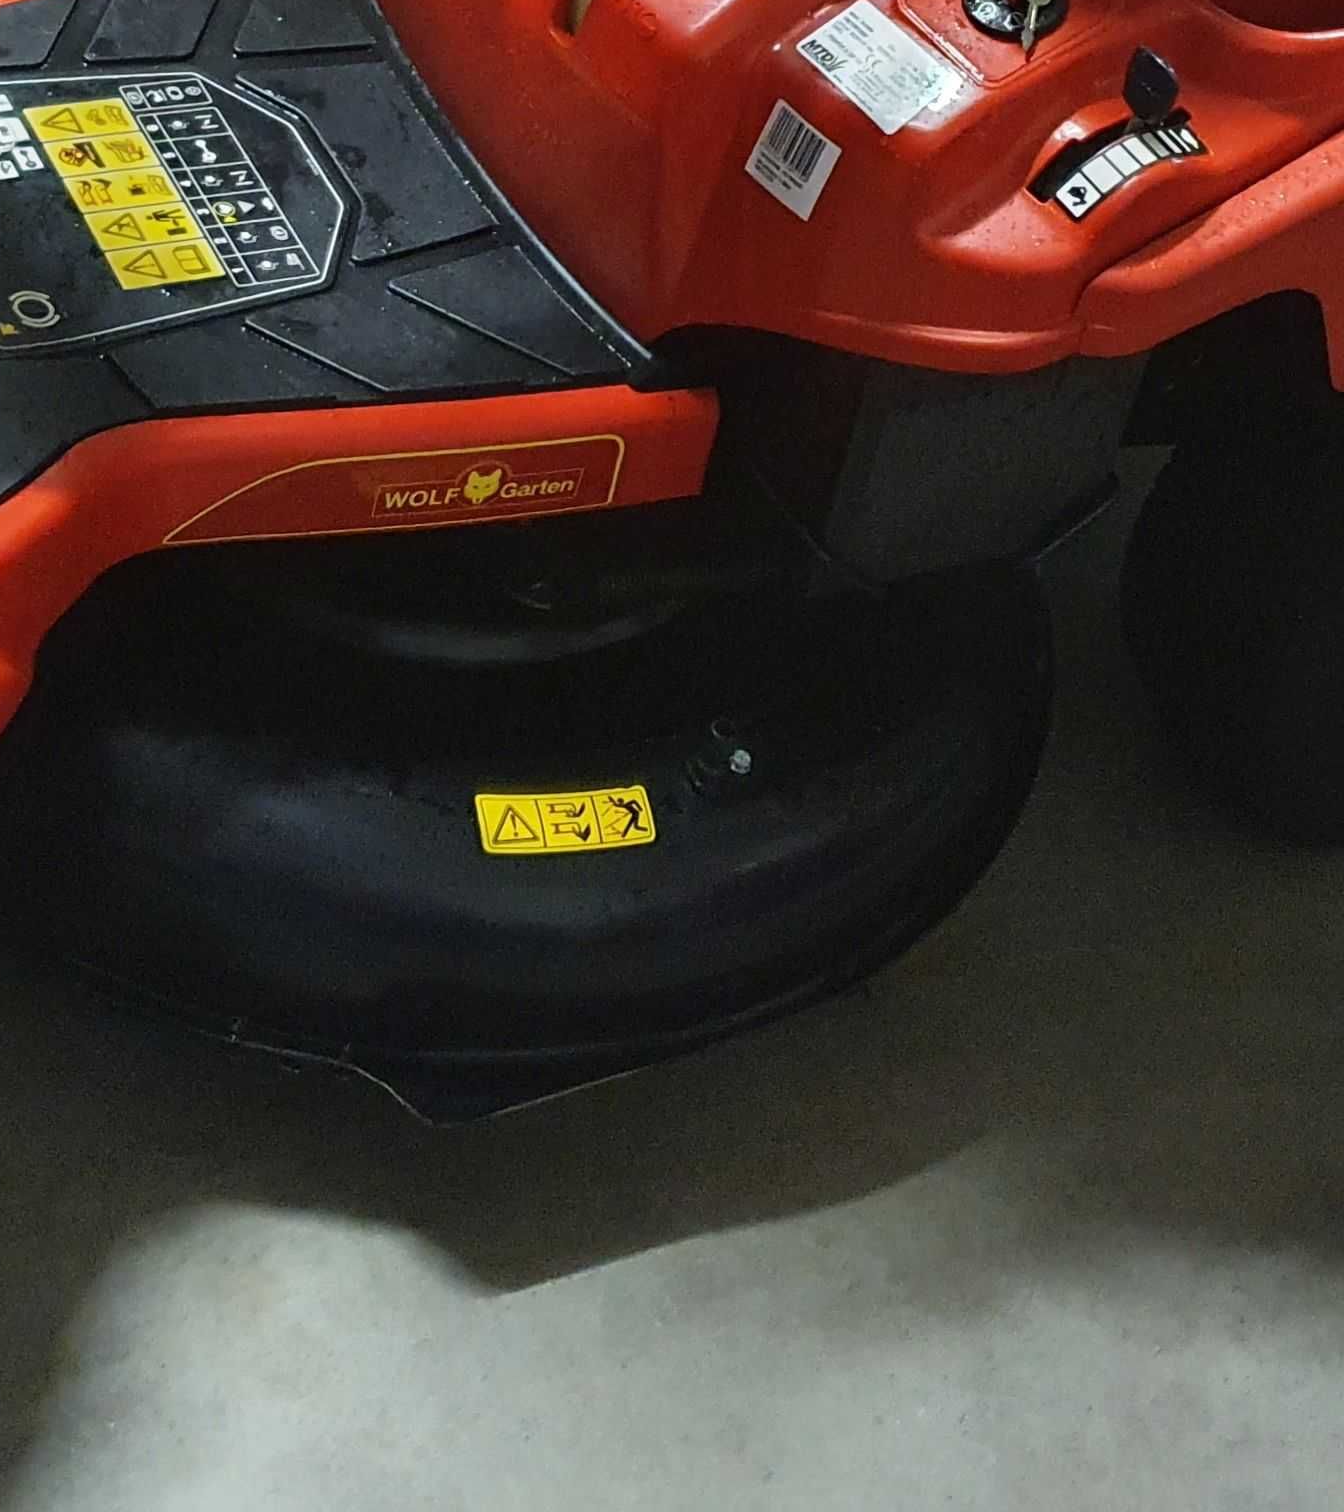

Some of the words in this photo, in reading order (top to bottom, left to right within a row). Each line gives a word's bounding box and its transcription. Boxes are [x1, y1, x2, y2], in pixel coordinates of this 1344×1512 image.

[801, 39, 835, 62] MTD
[384, 487, 461, 509] WOLF
[499, 479, 575, 500] Garten
